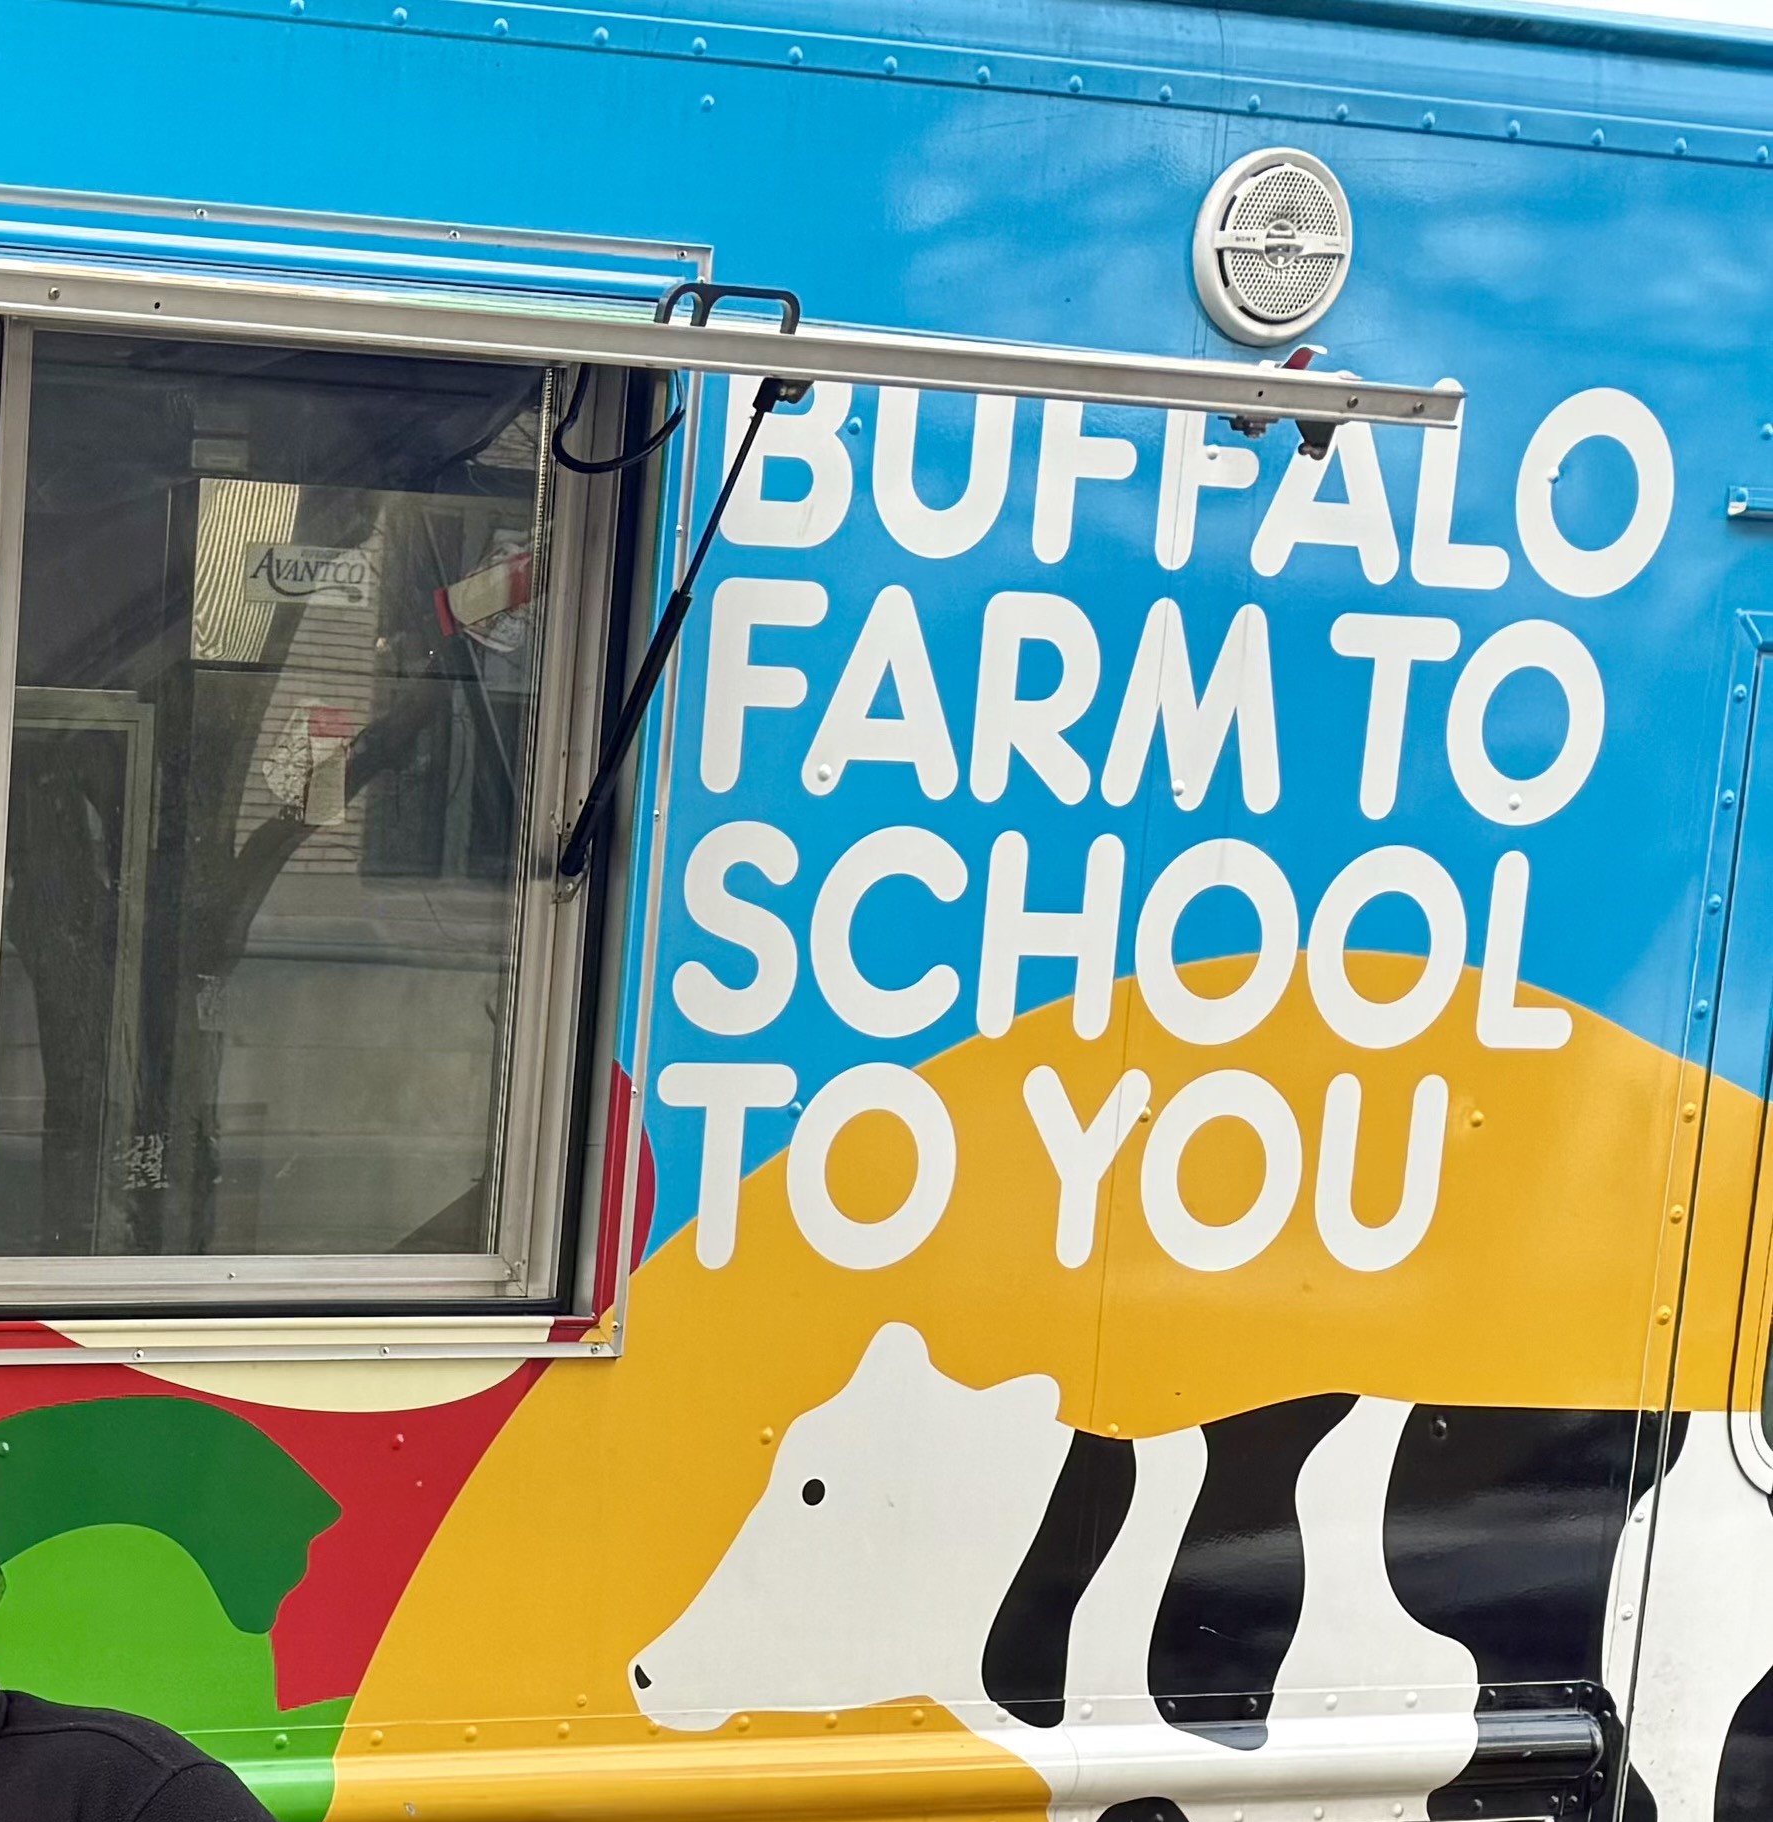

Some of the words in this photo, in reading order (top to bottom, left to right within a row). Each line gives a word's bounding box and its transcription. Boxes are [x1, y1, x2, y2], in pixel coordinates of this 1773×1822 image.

[716, 376, 1674, 598] BUFFALO
[699, 577, 1281, 814] FARM
[1330, 613, 1605, 827] TO
[671, 820, 1574, 1050] SCHOOL
[656, 1061, 956, 1271] TO
[1022, 1064, 1448, 1272] YOU
